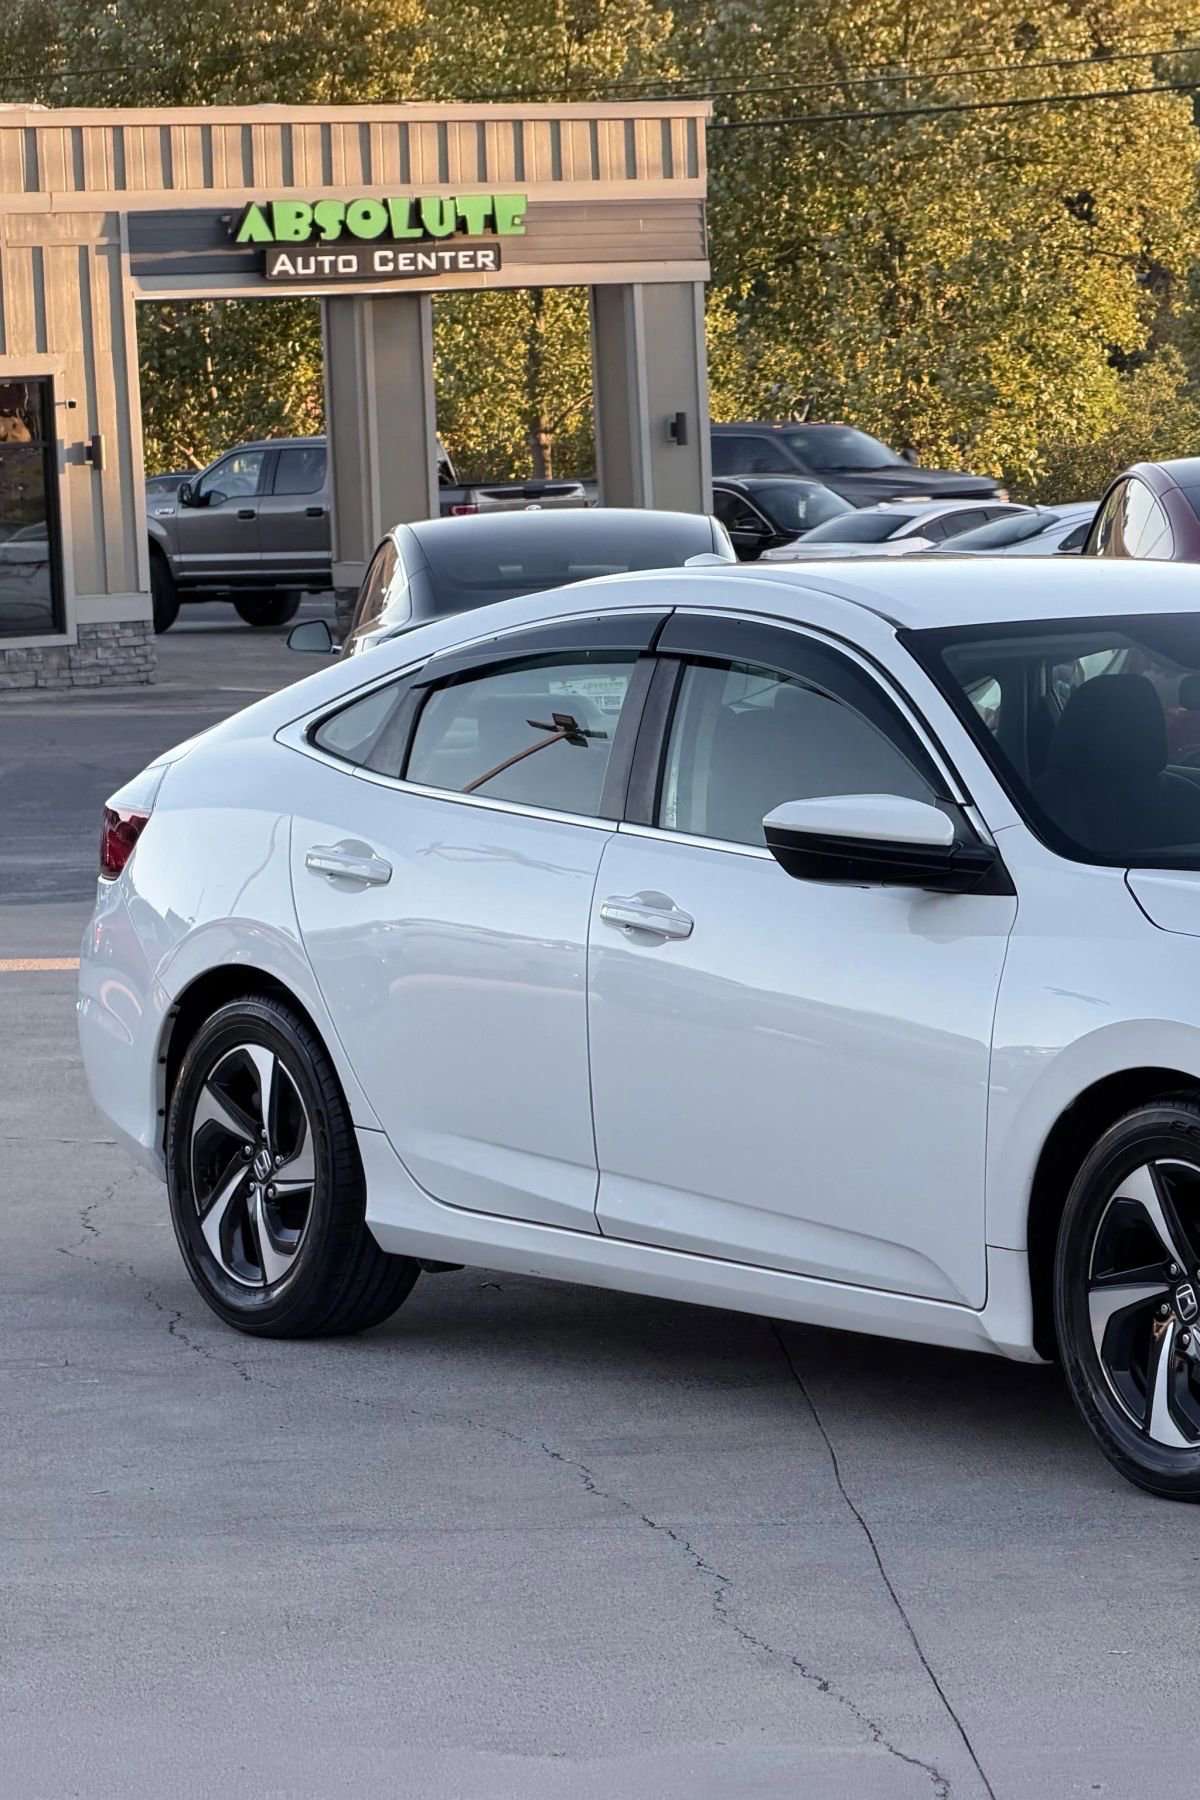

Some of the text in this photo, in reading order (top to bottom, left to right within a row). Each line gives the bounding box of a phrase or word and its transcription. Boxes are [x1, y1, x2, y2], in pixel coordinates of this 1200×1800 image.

[236, 194, 528, 243] ABSOLUTE
[271, 249, 498, 276] AUTO CENTER
